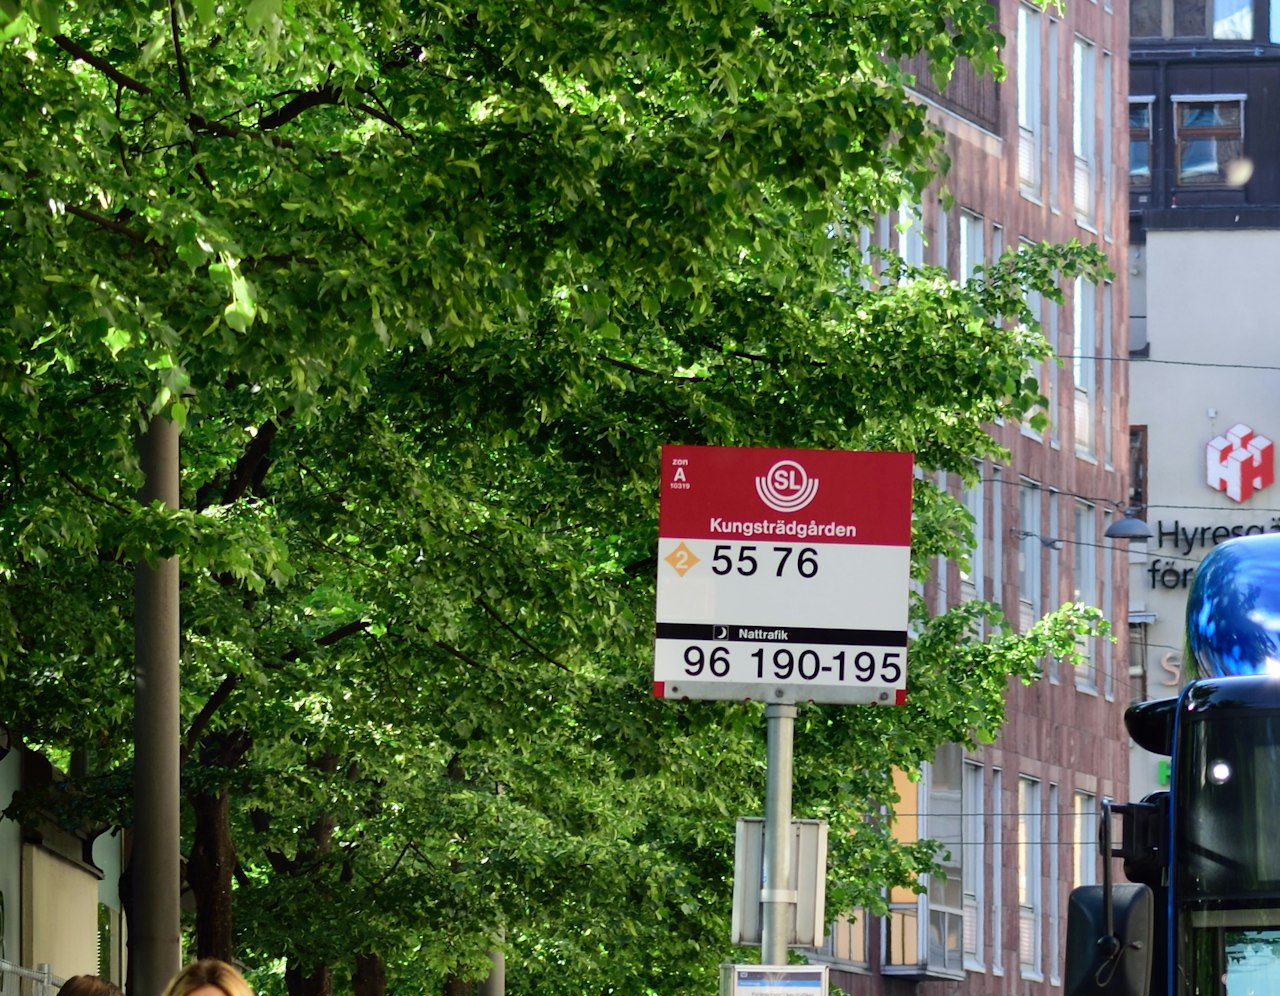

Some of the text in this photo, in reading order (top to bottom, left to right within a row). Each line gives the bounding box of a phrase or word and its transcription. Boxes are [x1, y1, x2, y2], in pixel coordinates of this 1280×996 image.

[673, 467, 686, 482] A
[773, 470, 802, 491] SL
[709, 517, 857, 538] Kungsträdgården
[675, 545, 819, 578] 2 55 76
[738, 628, 788, 641] Nattrafik
[683, 645, 901, 683] 96 190-195
